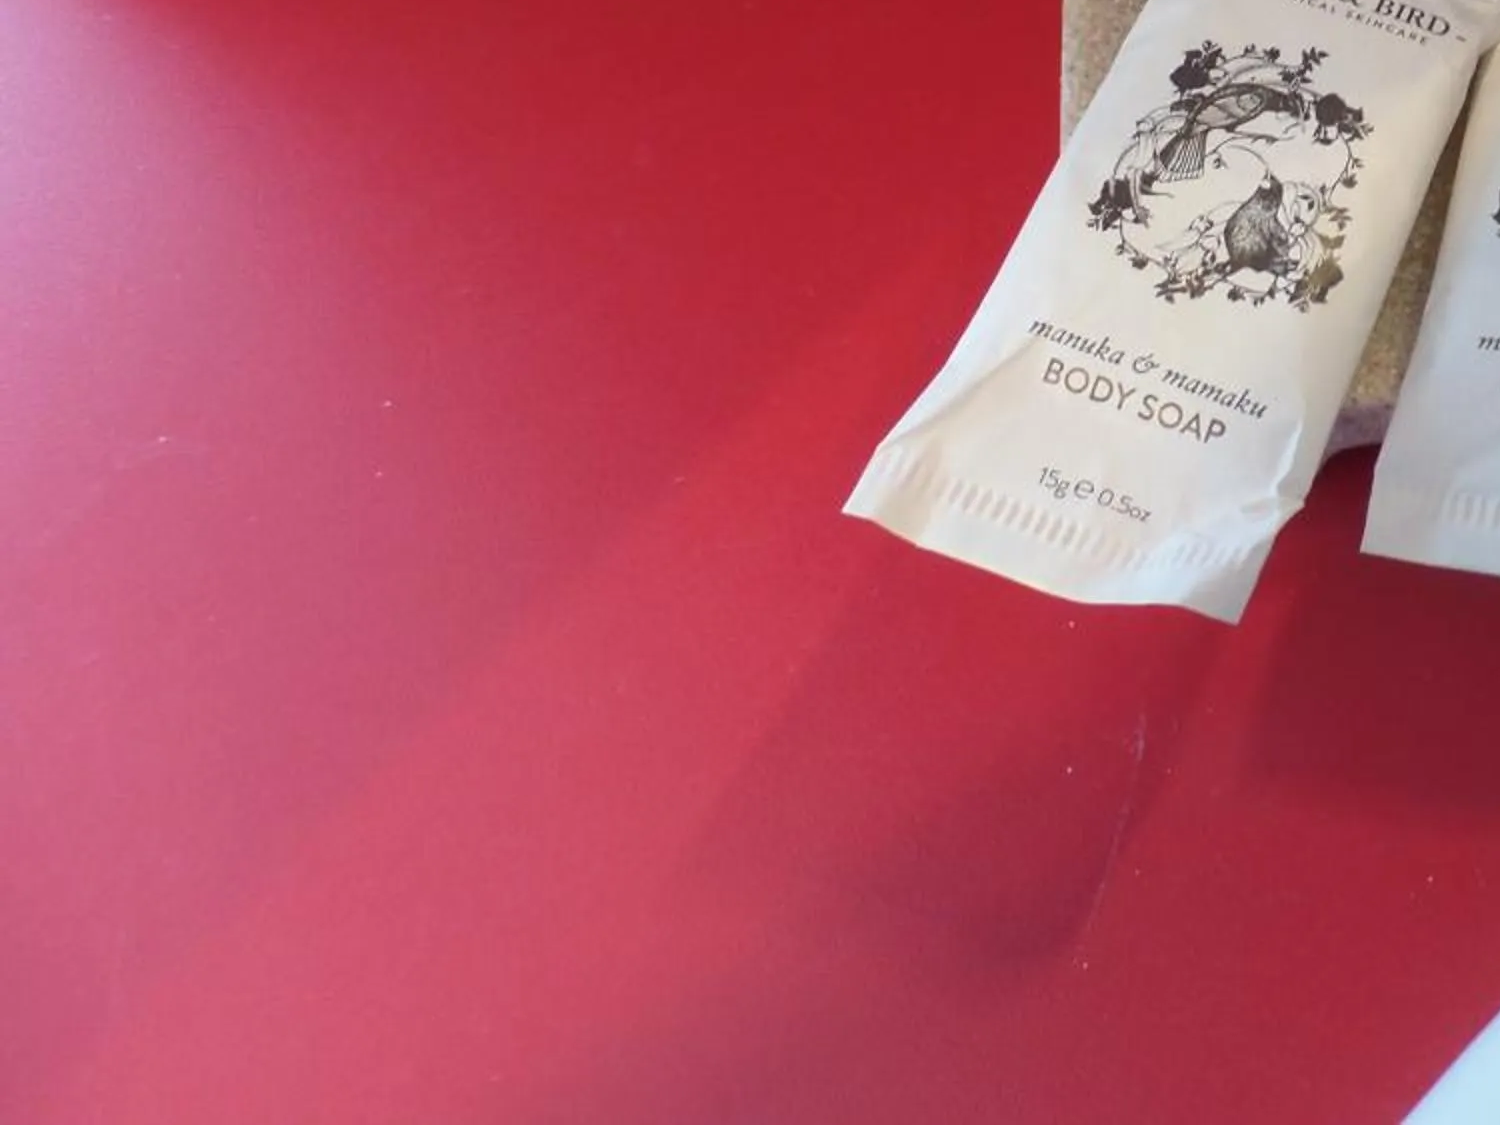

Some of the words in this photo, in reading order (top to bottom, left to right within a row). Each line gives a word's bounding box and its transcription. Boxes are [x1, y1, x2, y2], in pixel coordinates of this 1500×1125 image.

[1345, 9, 1430, 47] SKINCARE
[1028, 318, 1127, 367] manuka
[1131, 352, 1161, 375] &
[1161, 367, 1269, 420] mamaku
[1041, 356, 1138, 411] BODY
[1136, 393, 1228, 445] SOAP
[1038, 465, 1071, 500] 15g
[1096, 487, 1154, 523] 0.5oz
